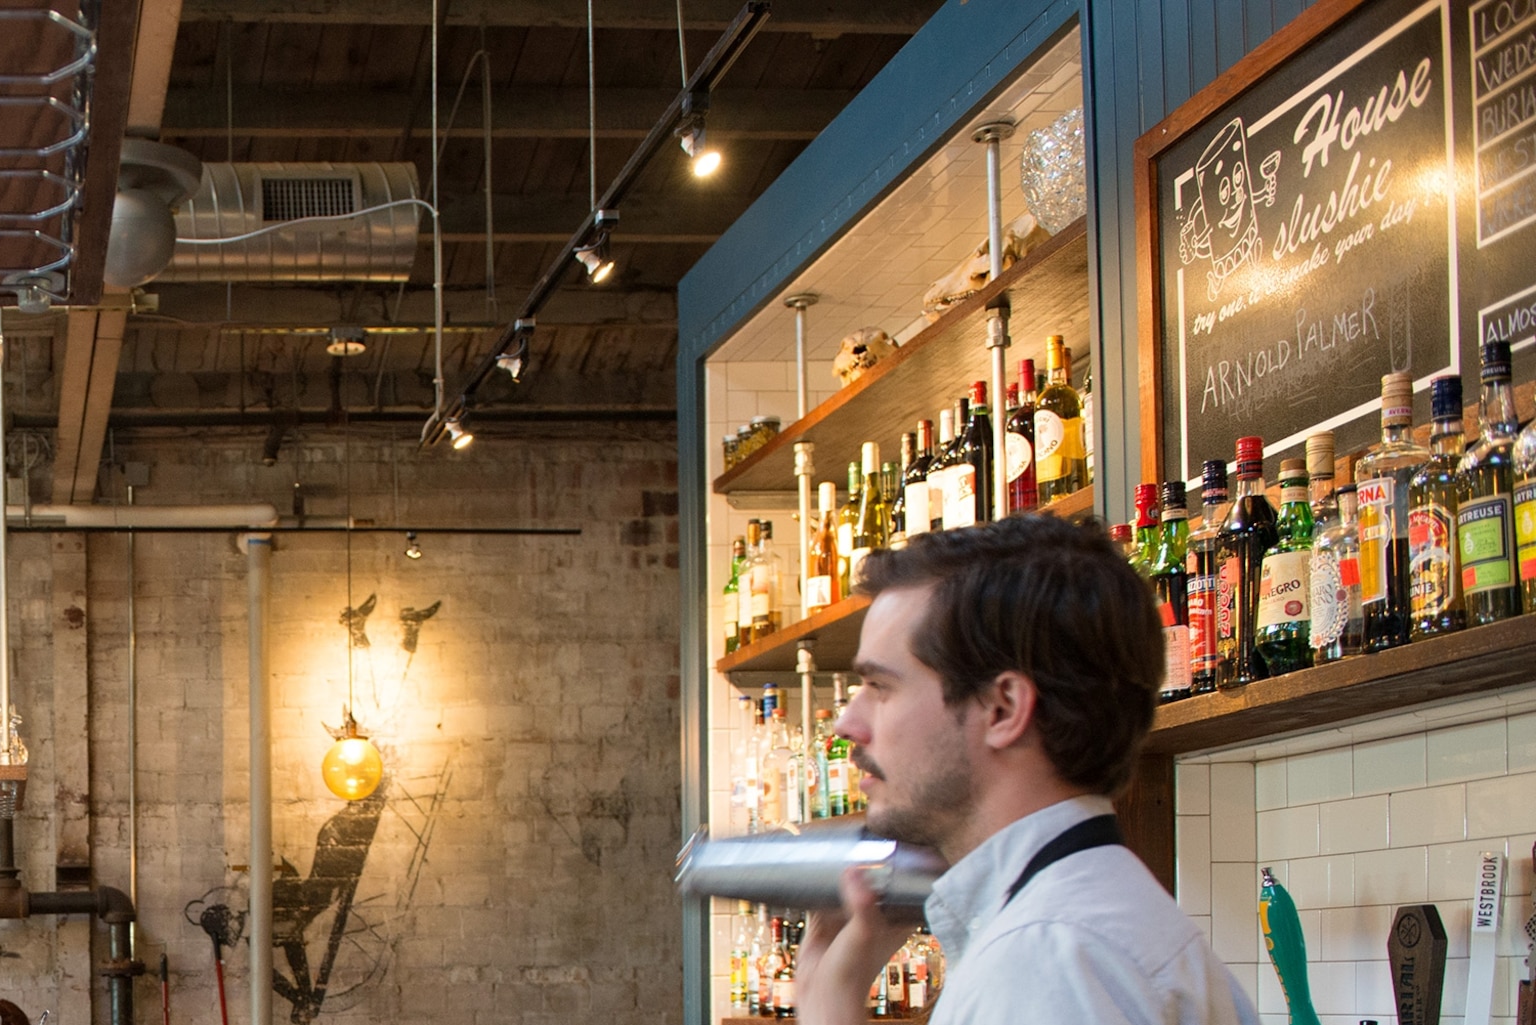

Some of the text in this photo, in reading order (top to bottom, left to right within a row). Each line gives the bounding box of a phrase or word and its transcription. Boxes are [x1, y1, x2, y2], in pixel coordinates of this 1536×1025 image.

[1293, 57, 1432, 178] House
[1272, 151, 1393, 261] slushie
[1194, 311, 1216, 335] try
[1335, 223, 1374, 265] your
[1201, 288, 1379, 414] ARNOLD PALMER
[1476, 856, 1498, 927] WESTBROOK
